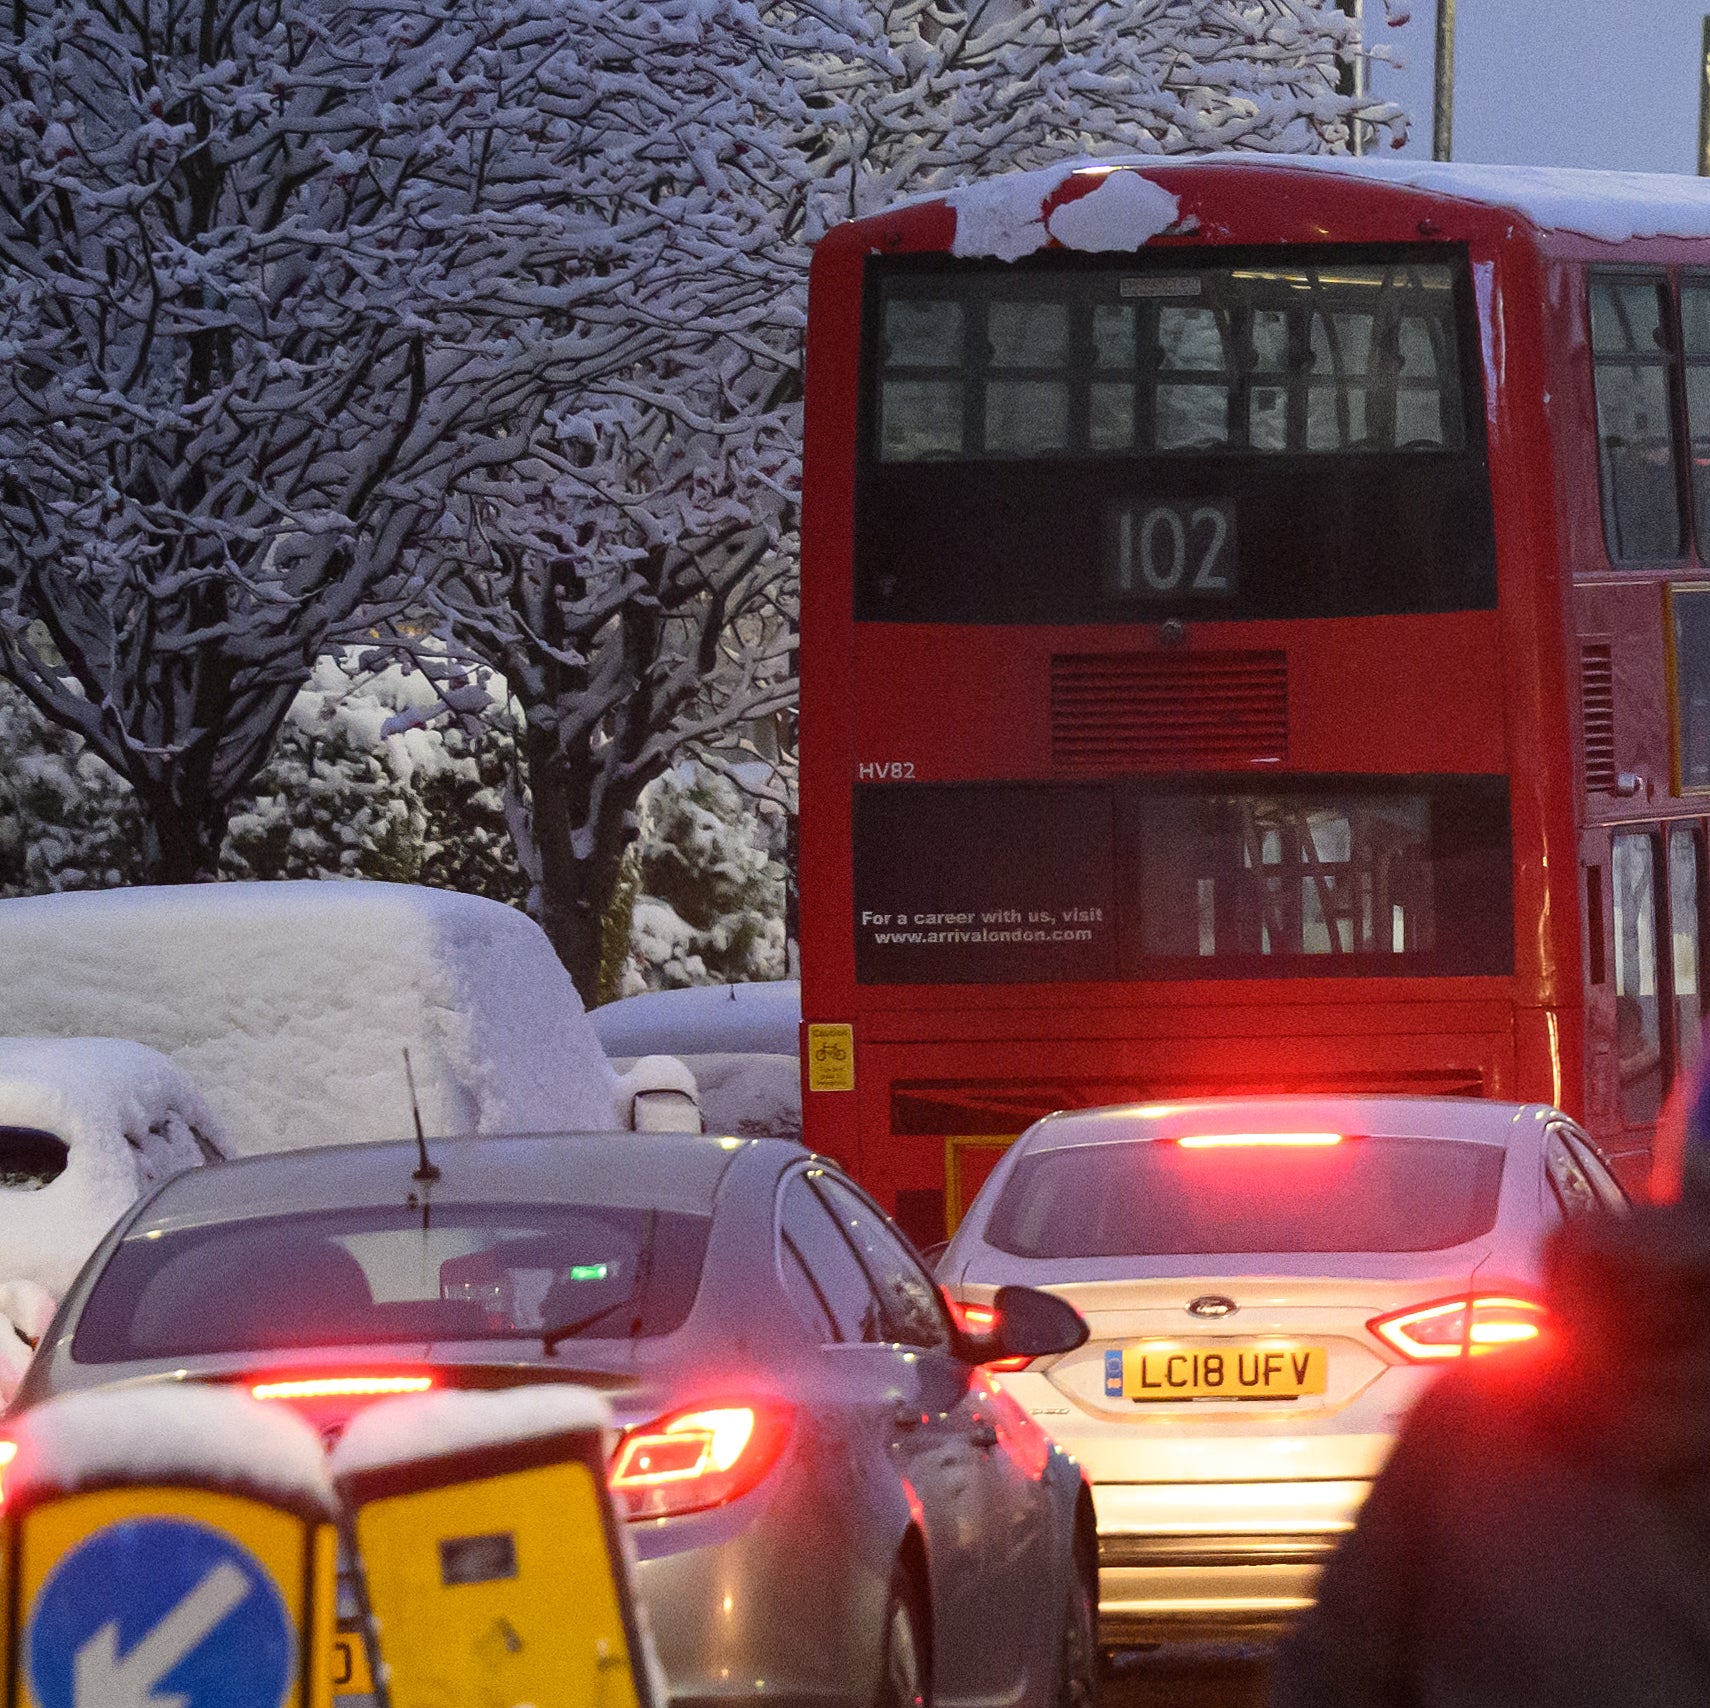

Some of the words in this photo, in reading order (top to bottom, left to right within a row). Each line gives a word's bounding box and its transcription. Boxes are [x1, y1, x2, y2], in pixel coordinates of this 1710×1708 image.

[1119, 508, 1227, 589] 102
[858, 762, 916, 780] HV82
[861, 911, 892, 926] For
[896, 913, 908, 925] a
[913, 911, 976, 925] career
[981, 908, 1022, 924] with
[1028, 910, 1057, 926] us,
[1062, 907, 1104, 923] visit
[874, 927, 1093, 945] www.arrivalondon.com
[1140, 1354, 1224, 1389] LC18
[1238, 1351, 1310, 1388] UFV
